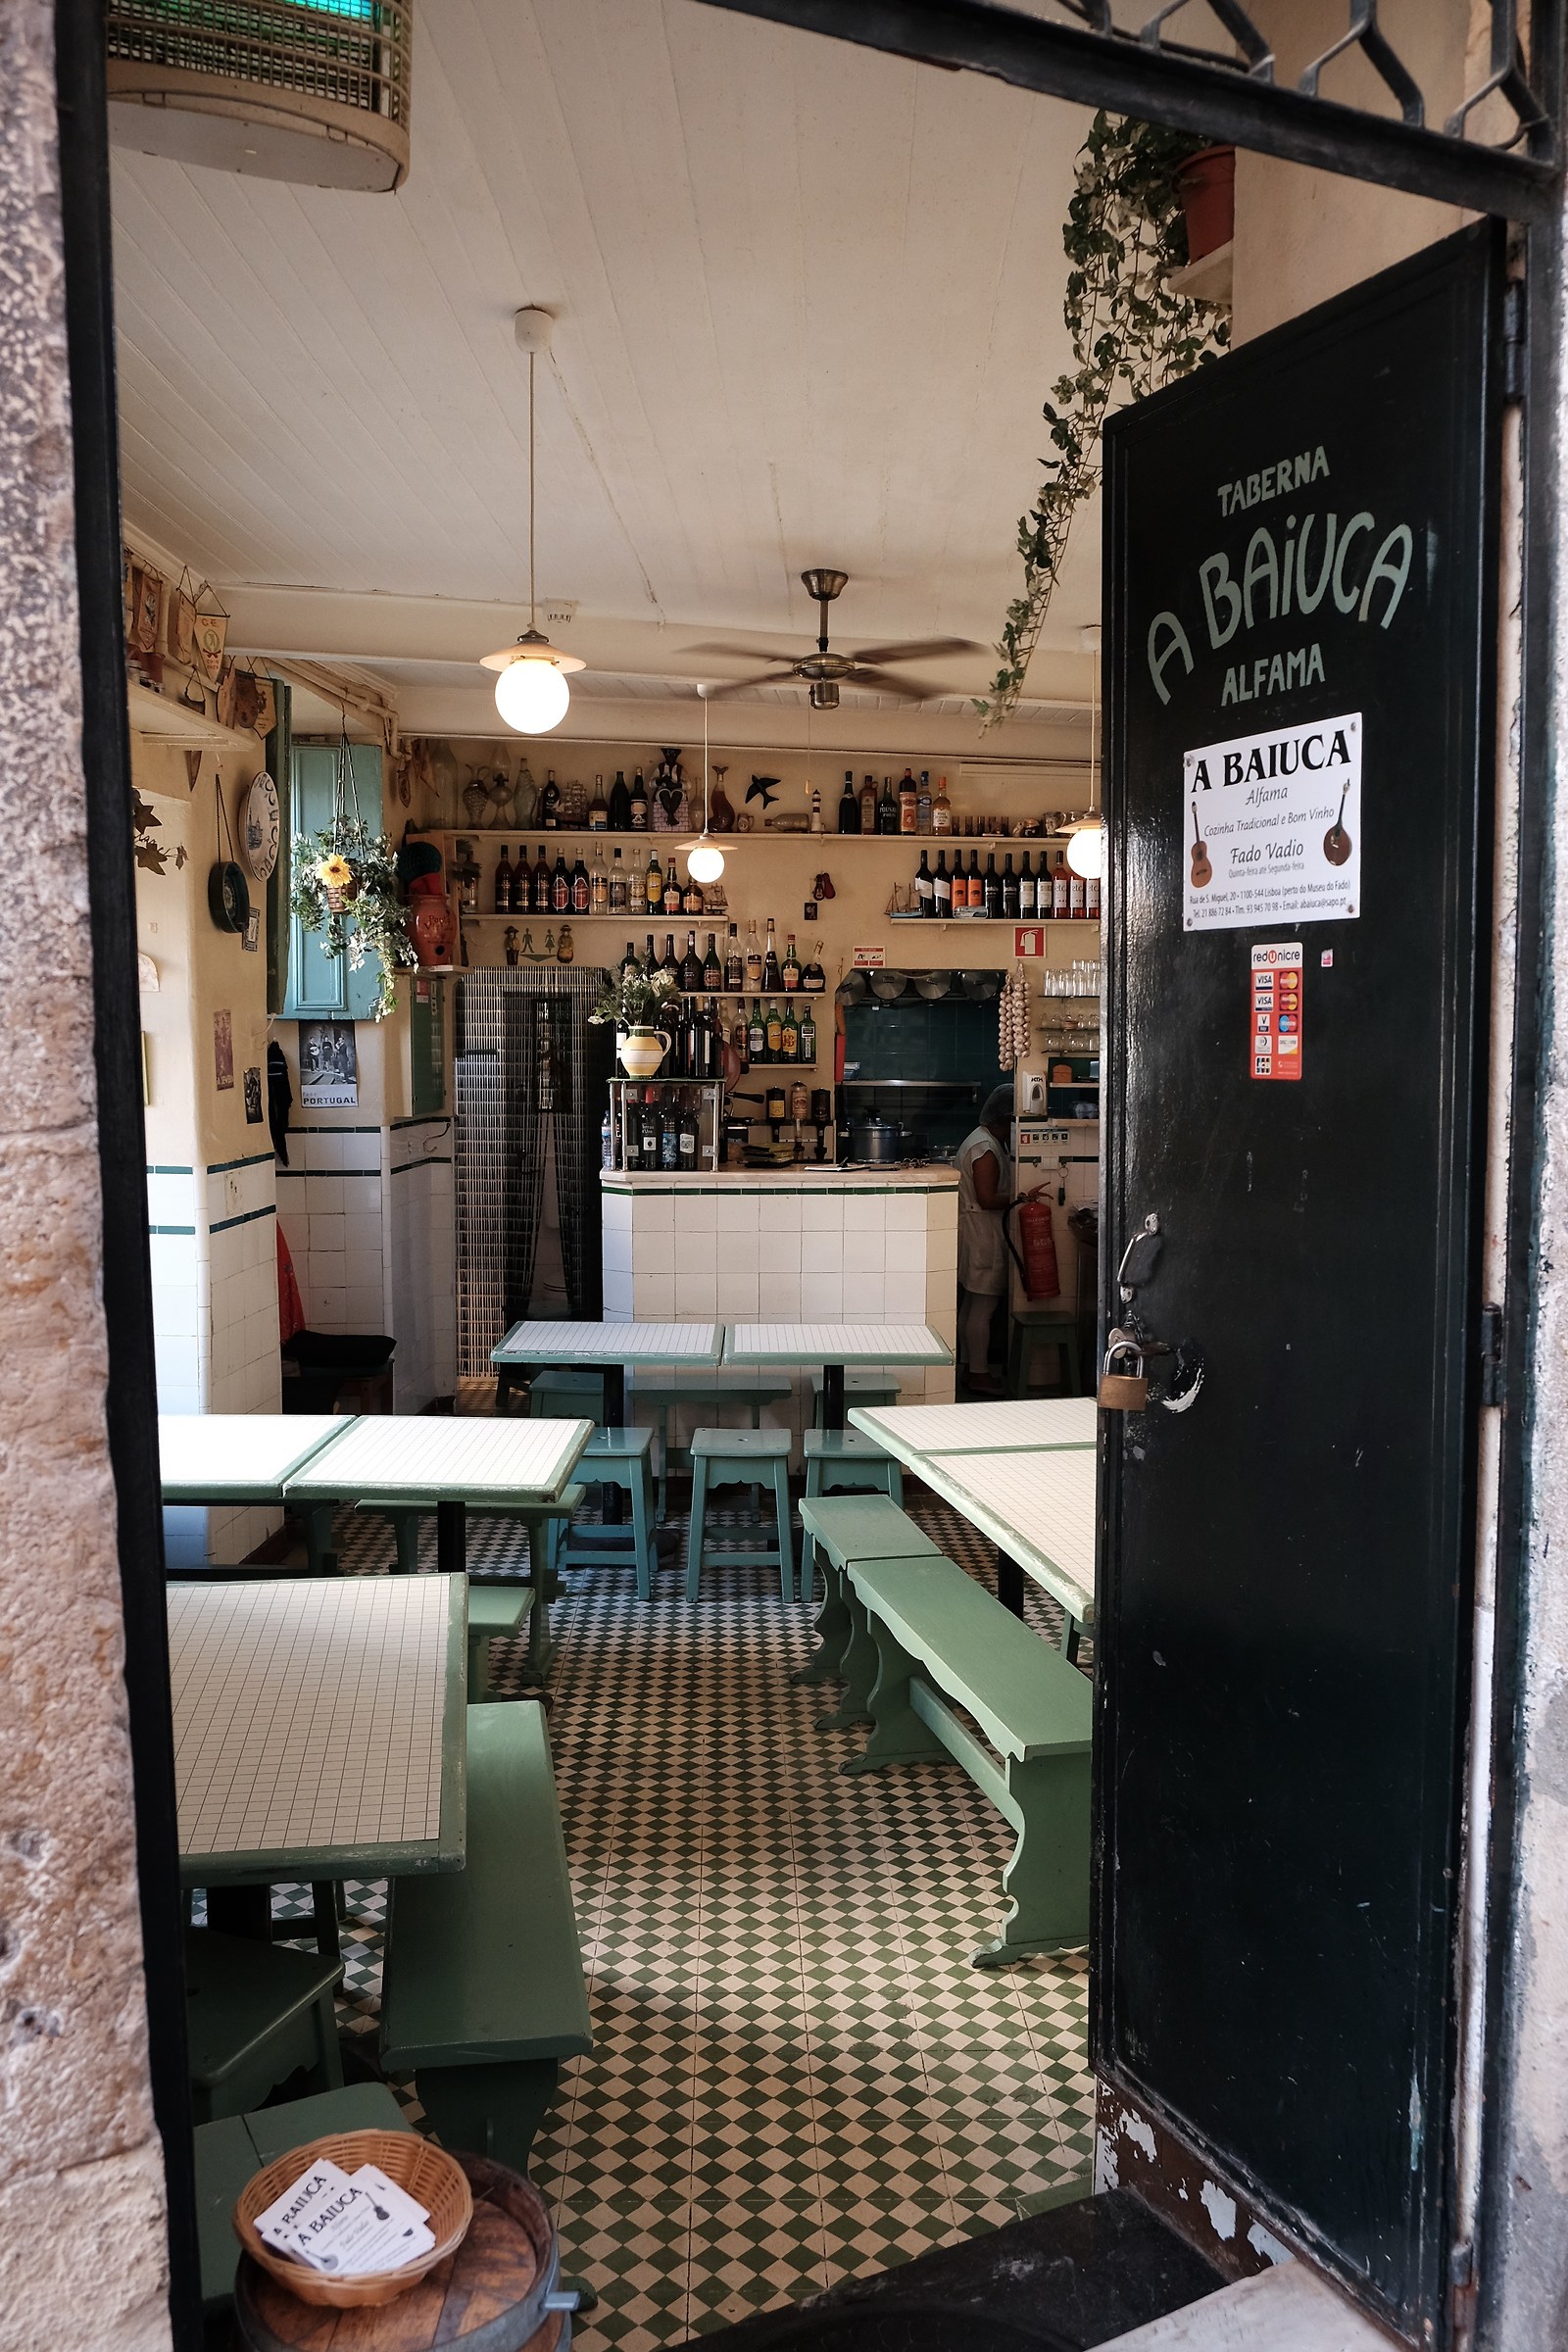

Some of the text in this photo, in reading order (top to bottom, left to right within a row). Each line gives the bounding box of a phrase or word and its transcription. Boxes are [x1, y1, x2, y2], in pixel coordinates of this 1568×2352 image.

[1217, 445, 1331, 517] TABERNA
[1148, 612, 1195, 706] A
[1221, 643, 1326, 707] ALFAMA
[1191, 729, 1351, 793] A BAIUCA
[1245, 786, 1288, 808] Alfama
[1203, 806, 1335, 837] Cozinha Tradicional e Bom Vinho
[1230, 839, 1304, 864] Fado Vadio
[1265, 886, 1281, 897] Lisboa
[1257, 975, 1272, 984] VISA
[298, 2232, 312, 2246] A
[310, 2188, 363, 2233] BAIUCA
